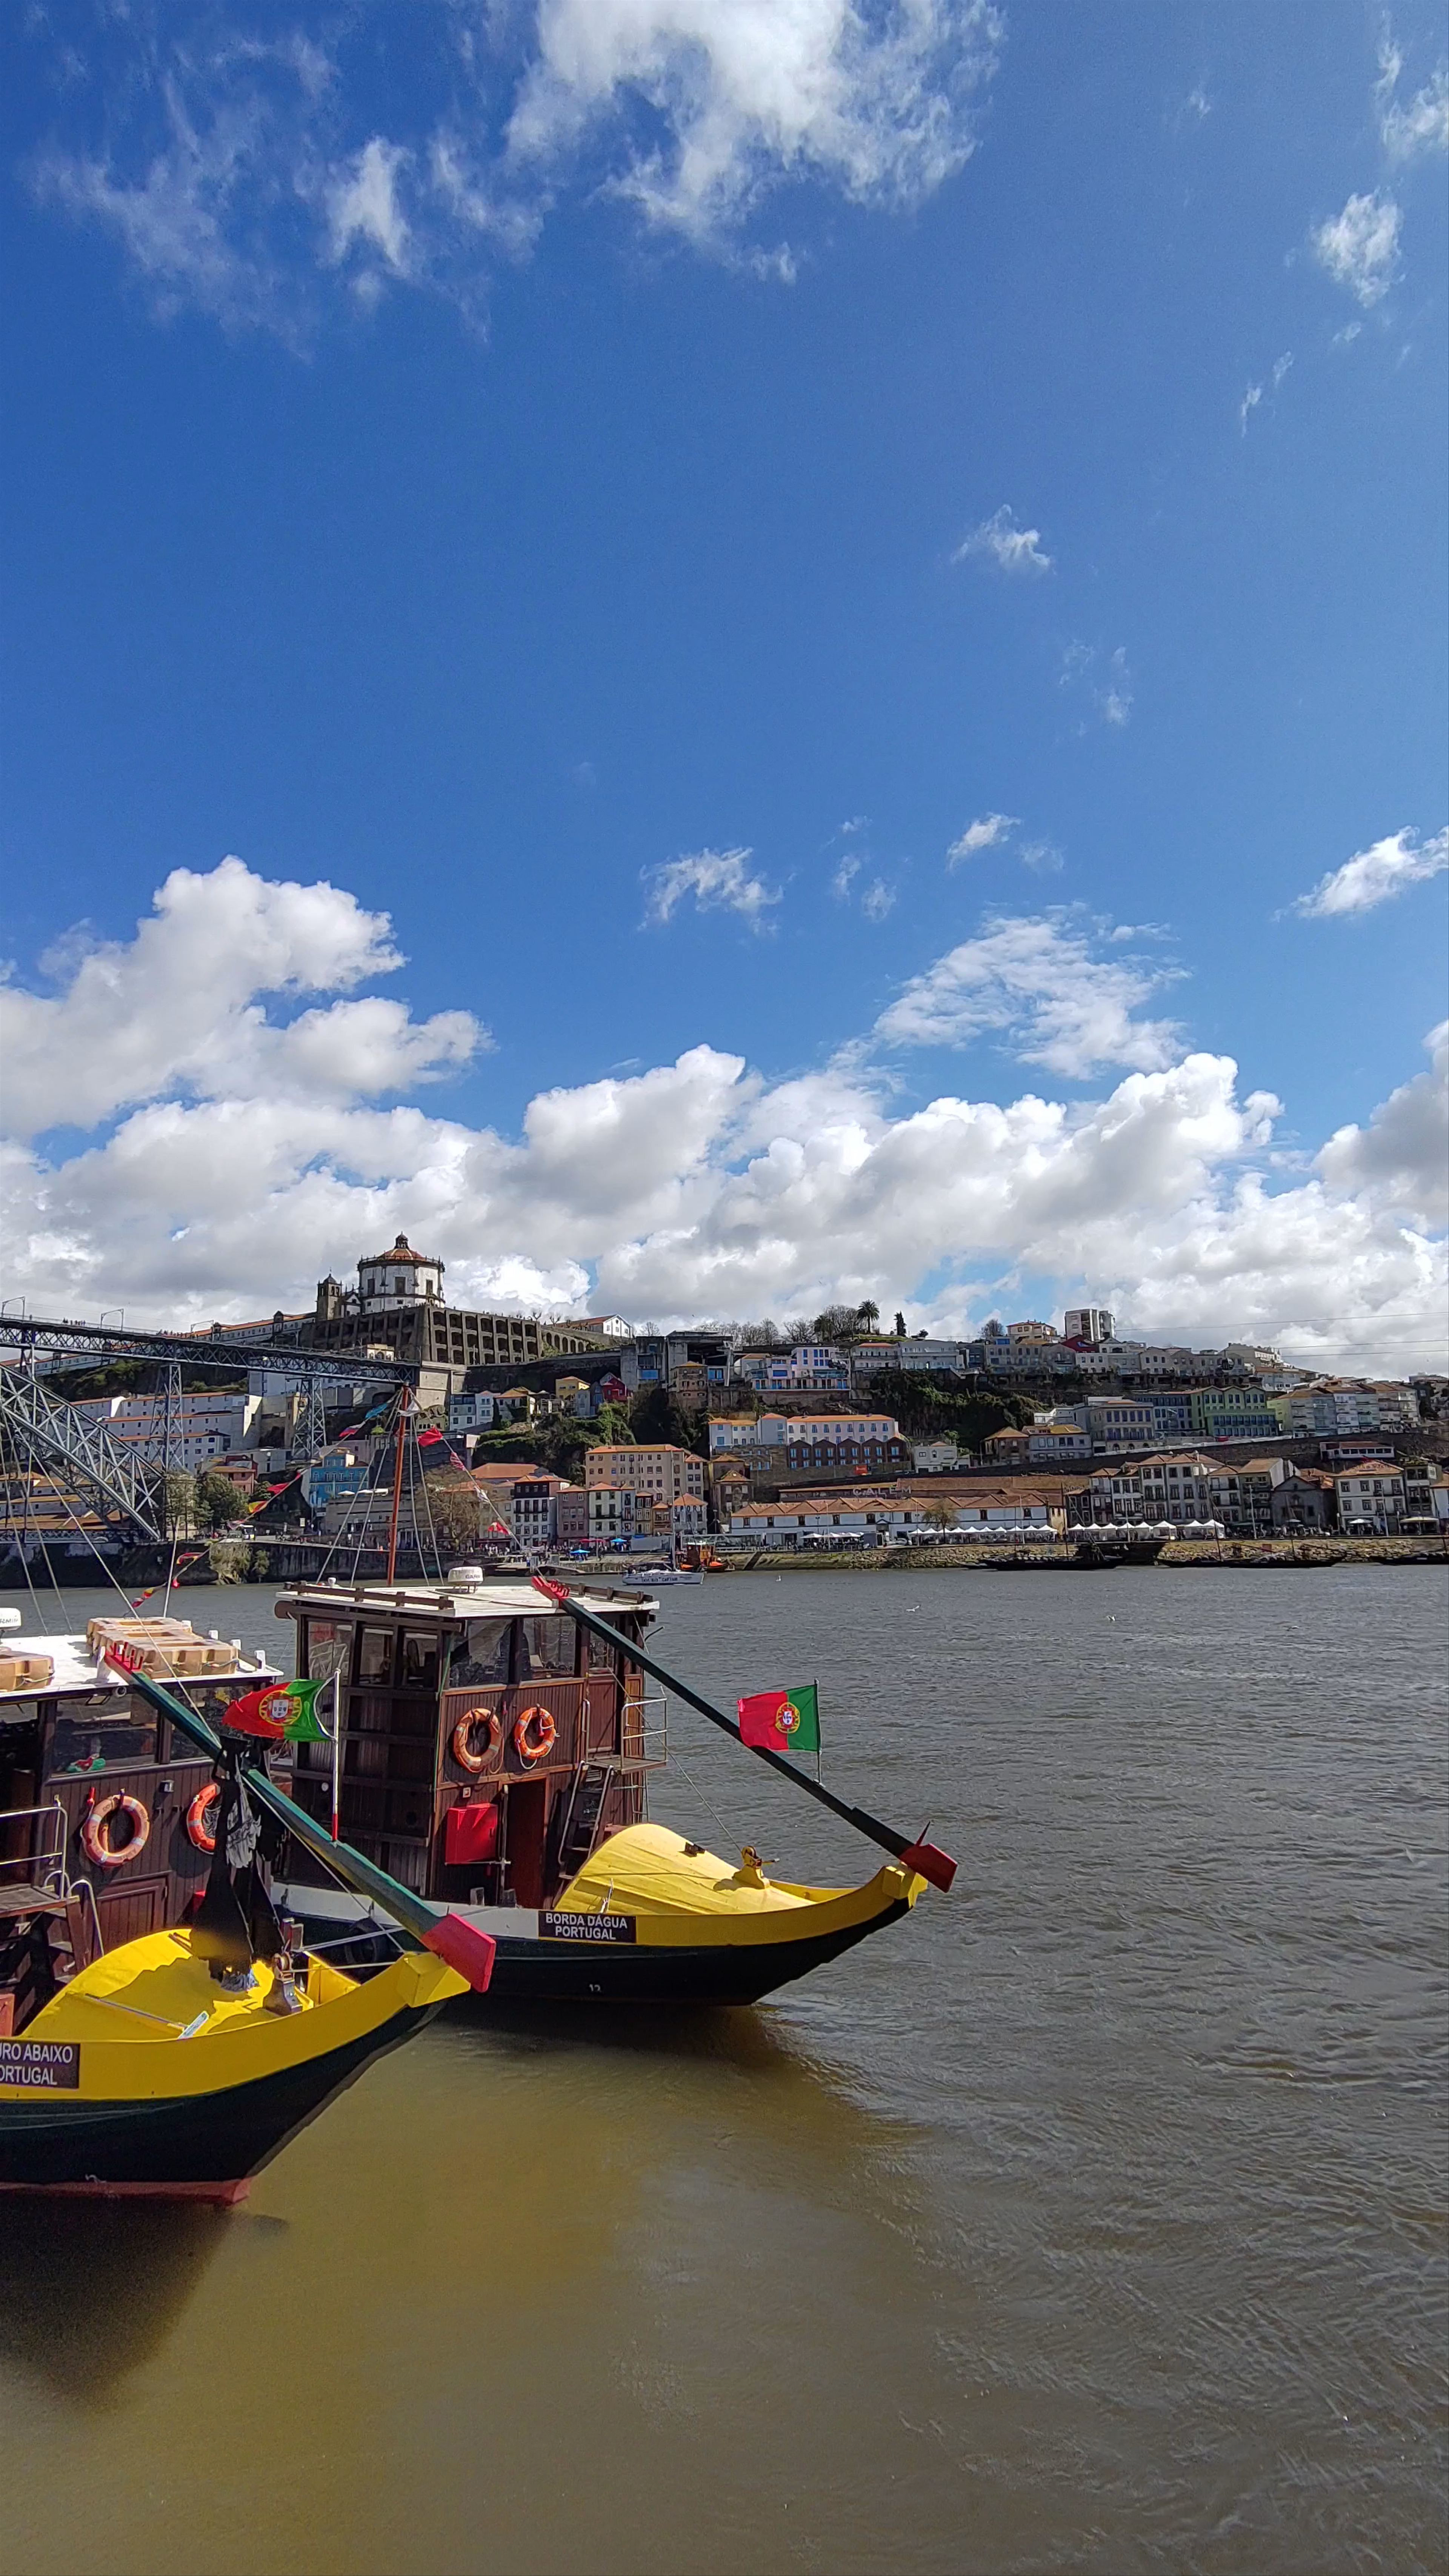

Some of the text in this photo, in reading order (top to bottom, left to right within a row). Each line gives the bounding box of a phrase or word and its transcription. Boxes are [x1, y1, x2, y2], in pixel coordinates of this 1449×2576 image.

[546, 1913, 585, 1925] BORDA
[555, 1925, 616, 1940] PORTUGAL
[0, 2042, 73, 2063] RO ABAIXO
